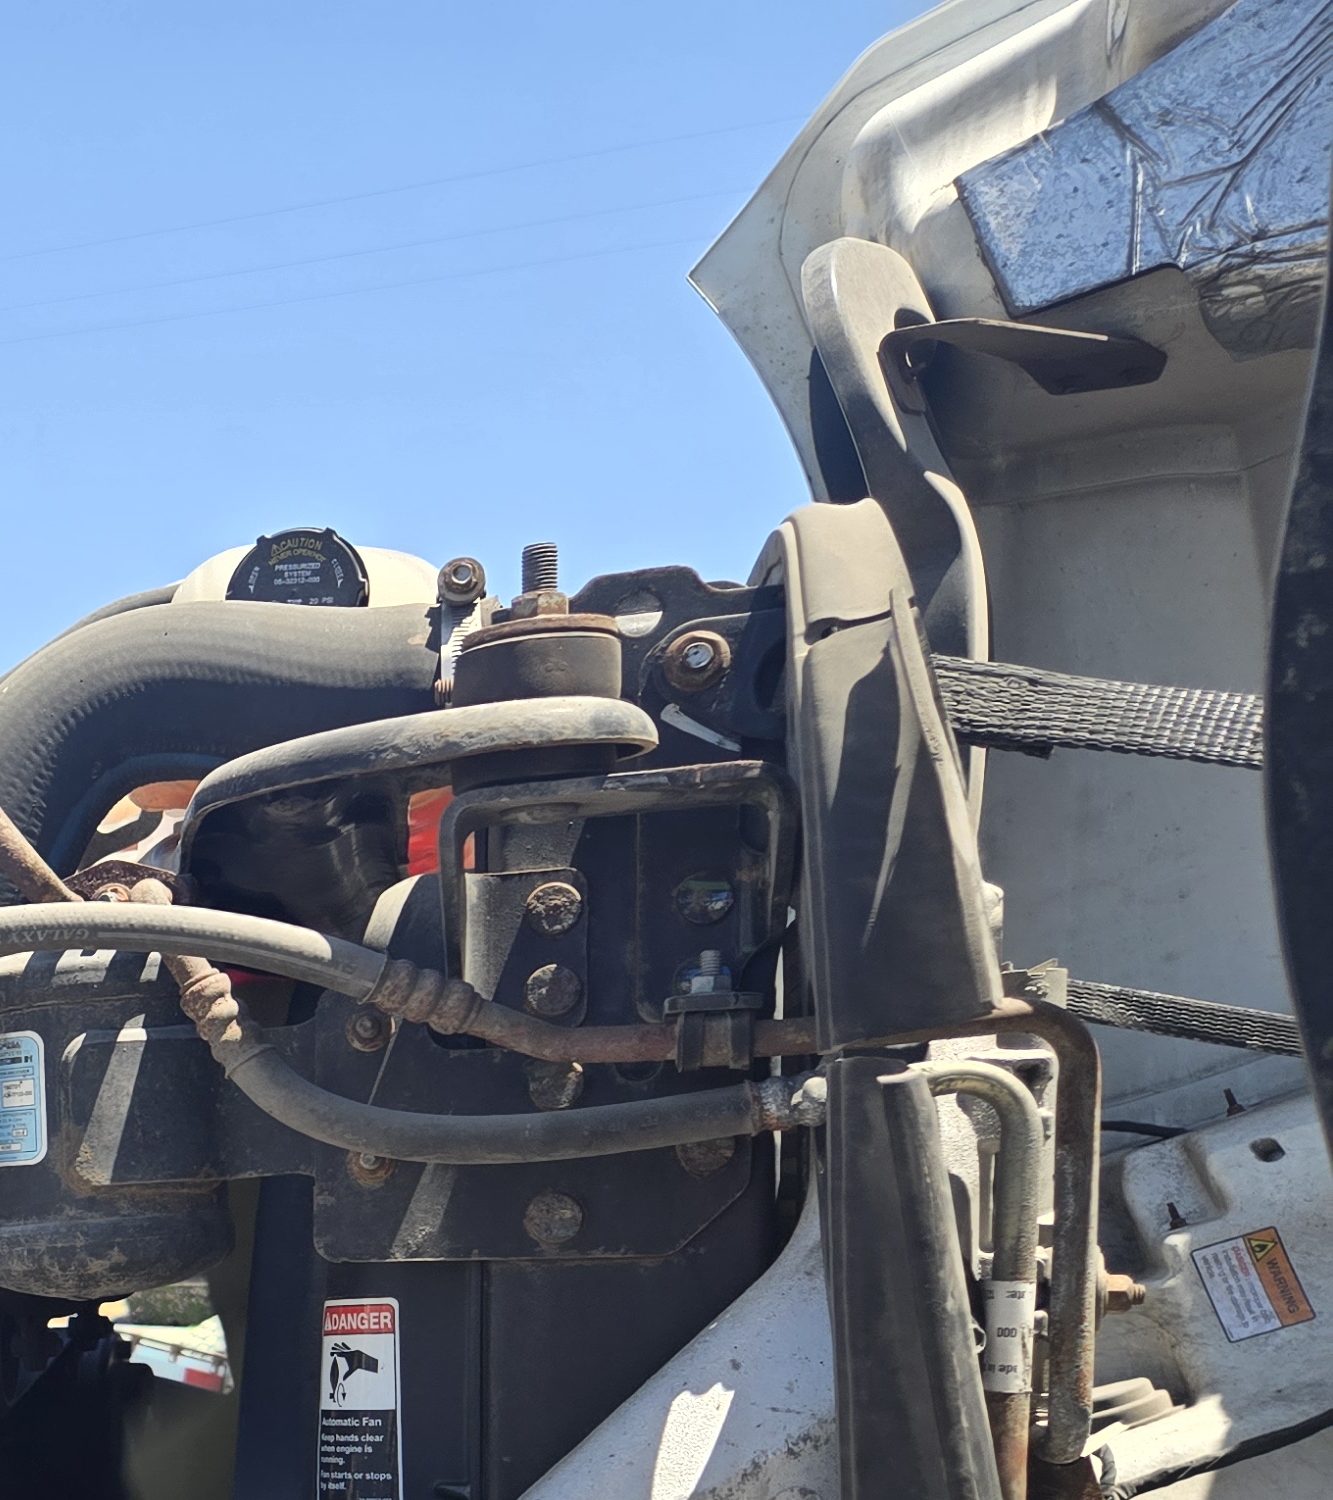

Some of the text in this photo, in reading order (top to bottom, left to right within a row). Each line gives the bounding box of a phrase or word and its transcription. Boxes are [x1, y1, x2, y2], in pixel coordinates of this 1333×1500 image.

[279, 537, 323, 550] CAUTION
[274, 562, 321, 572] PRESSURIZED
[283, 570, 312, 578] SYSTEM
[5, 927, 90, 945] GALAXY
[1266, 1257, 1300, 1315] WARNING
[331, 1311, 393, 1330] DANGER
[321, 1417, 382, 1427] Automatic Fan
[321, 1433, 384, 1443] Keep hands clear
[336, 1446, 363, 1455] engine
[364, 1444, 373, 1453] is
[320, 1470, 392, 1481] Fan starts or stops
[320, 1482, 327, 1491] by
